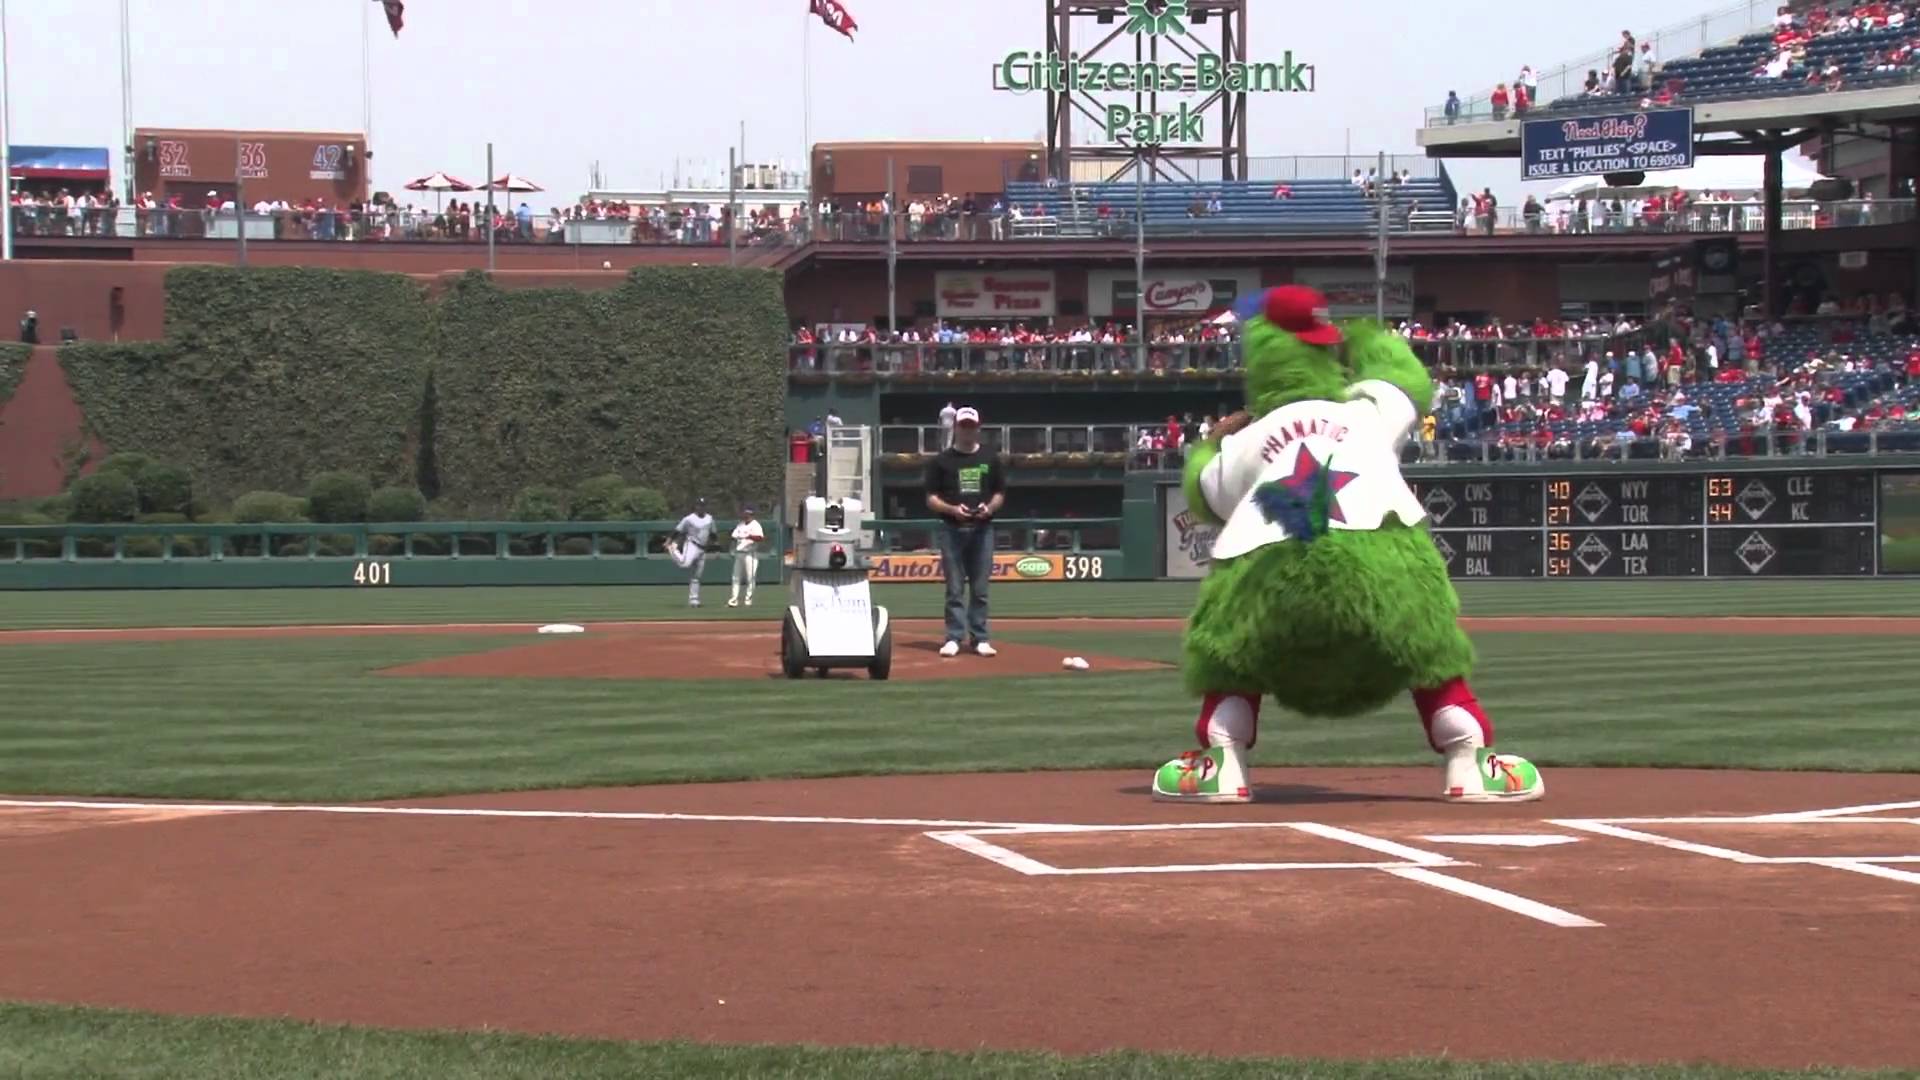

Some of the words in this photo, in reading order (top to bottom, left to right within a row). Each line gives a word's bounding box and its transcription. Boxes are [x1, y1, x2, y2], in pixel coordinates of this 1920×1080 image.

[1001, 50, 1185, 92] Citizens
[1196, 50, 1309, 92] Bank
[1106, 101, 1204, 142] Park
[1562, 120, 1600, 142] Need
[1600, 113, 1648, 142] Help?
[159, 140, 189, 166] 32
[239, 142, 266, 169] 36
[312, 144, 341, 170] 42
[1539, 148, 1566, 161] TEXT
[1627, 140, 1677, 154] <SPACE>
[1528, 162, 1559, 176] ISSUE
[1562, 162, 1570, 173] &
[1573, 157, 1630, 173] LOCATION
[1632, 155, 1648, 168] TO
[1649, 153, 1686, 167] 69050
[1261, 418, 1349, 464] PHANATIC
[1465, 483, 1493, 501] CWS
[1548, 482, 1570, 499] 40
[1621, 480, 1649, 499] NYY
[1709, 478, 1732, 497] 63
[1787, 476, 1813, 496] CLE
[1470, 507, 1487, 525] TB
[1548, 506, 1570, 524] 27
[1621, 504, 1649, 523] TOR
[1709, 503, 1732, 521] 44
[1791, 502, 1809, 521] KC
[1466, 534, 1492, 552] MIN
[1548, 533, 1570, 551] 36
[1621, 532, 1649, 551] LAA
[353, 561, 391, 585] 401
[1065, 556, 1102, 580] 398
[1466, 557, 1491, 575] BAL
[1548, 557, 1571, 575] 54
[1621, 556, 1648, 575] TEX
